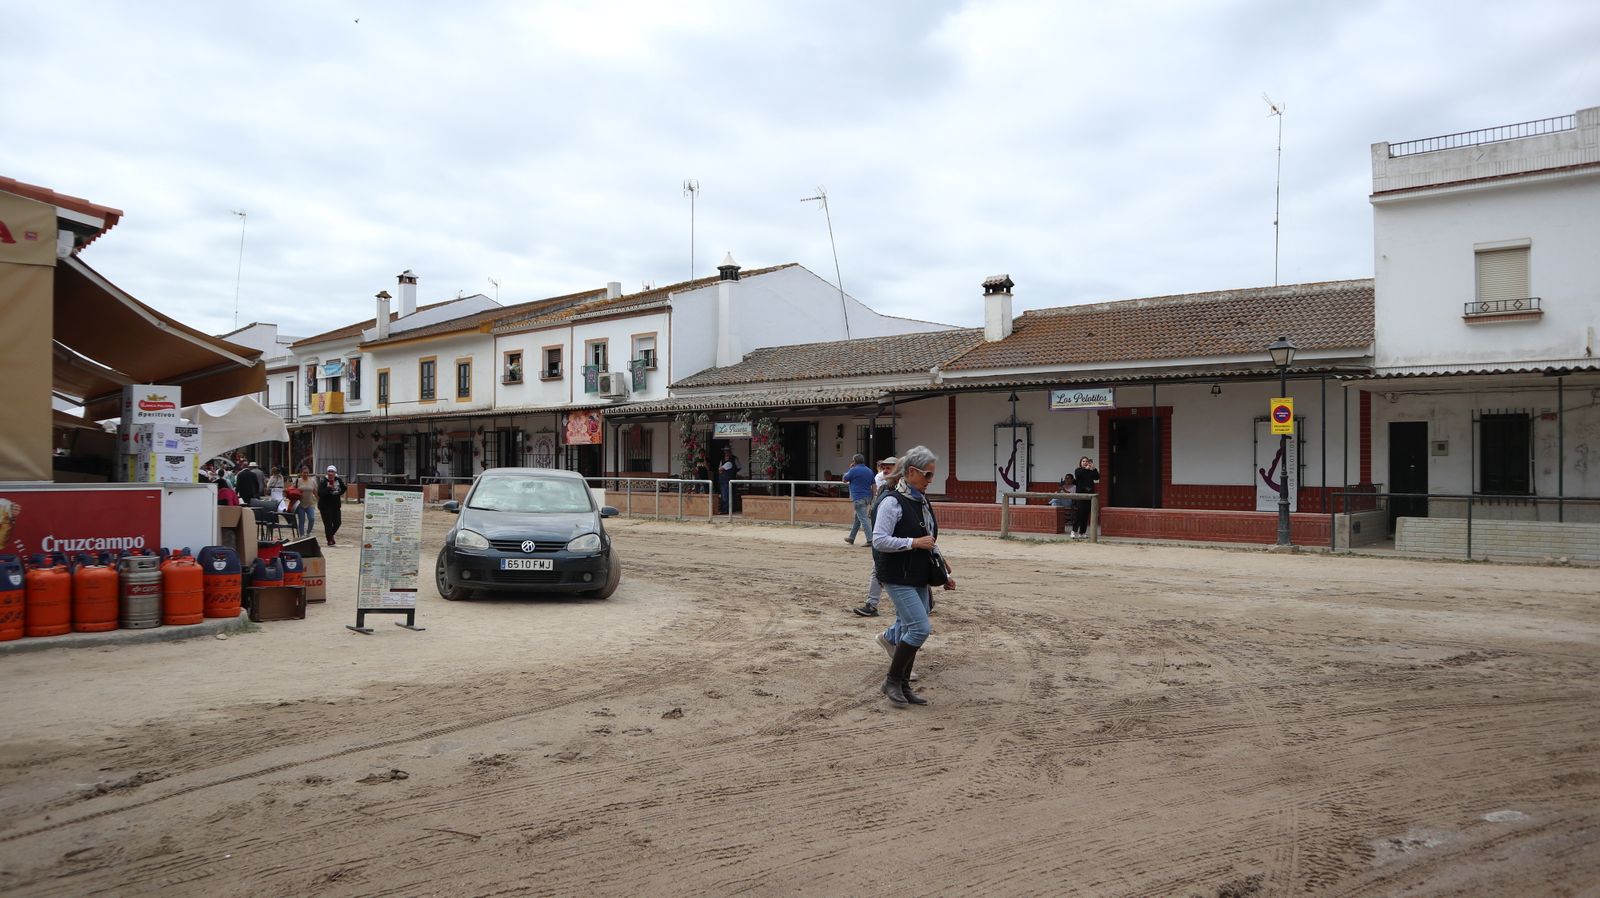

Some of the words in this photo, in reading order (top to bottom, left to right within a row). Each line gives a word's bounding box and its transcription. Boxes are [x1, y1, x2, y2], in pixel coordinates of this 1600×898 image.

[1056, 392, 1072, 404] Los
[1073, 391, 1108, 403] Pelotitos
[41, 535, 145, 552] Cruzcampo
[507, 560, 531, 569] 6510
[533, 560, 551, 570] FMJ
